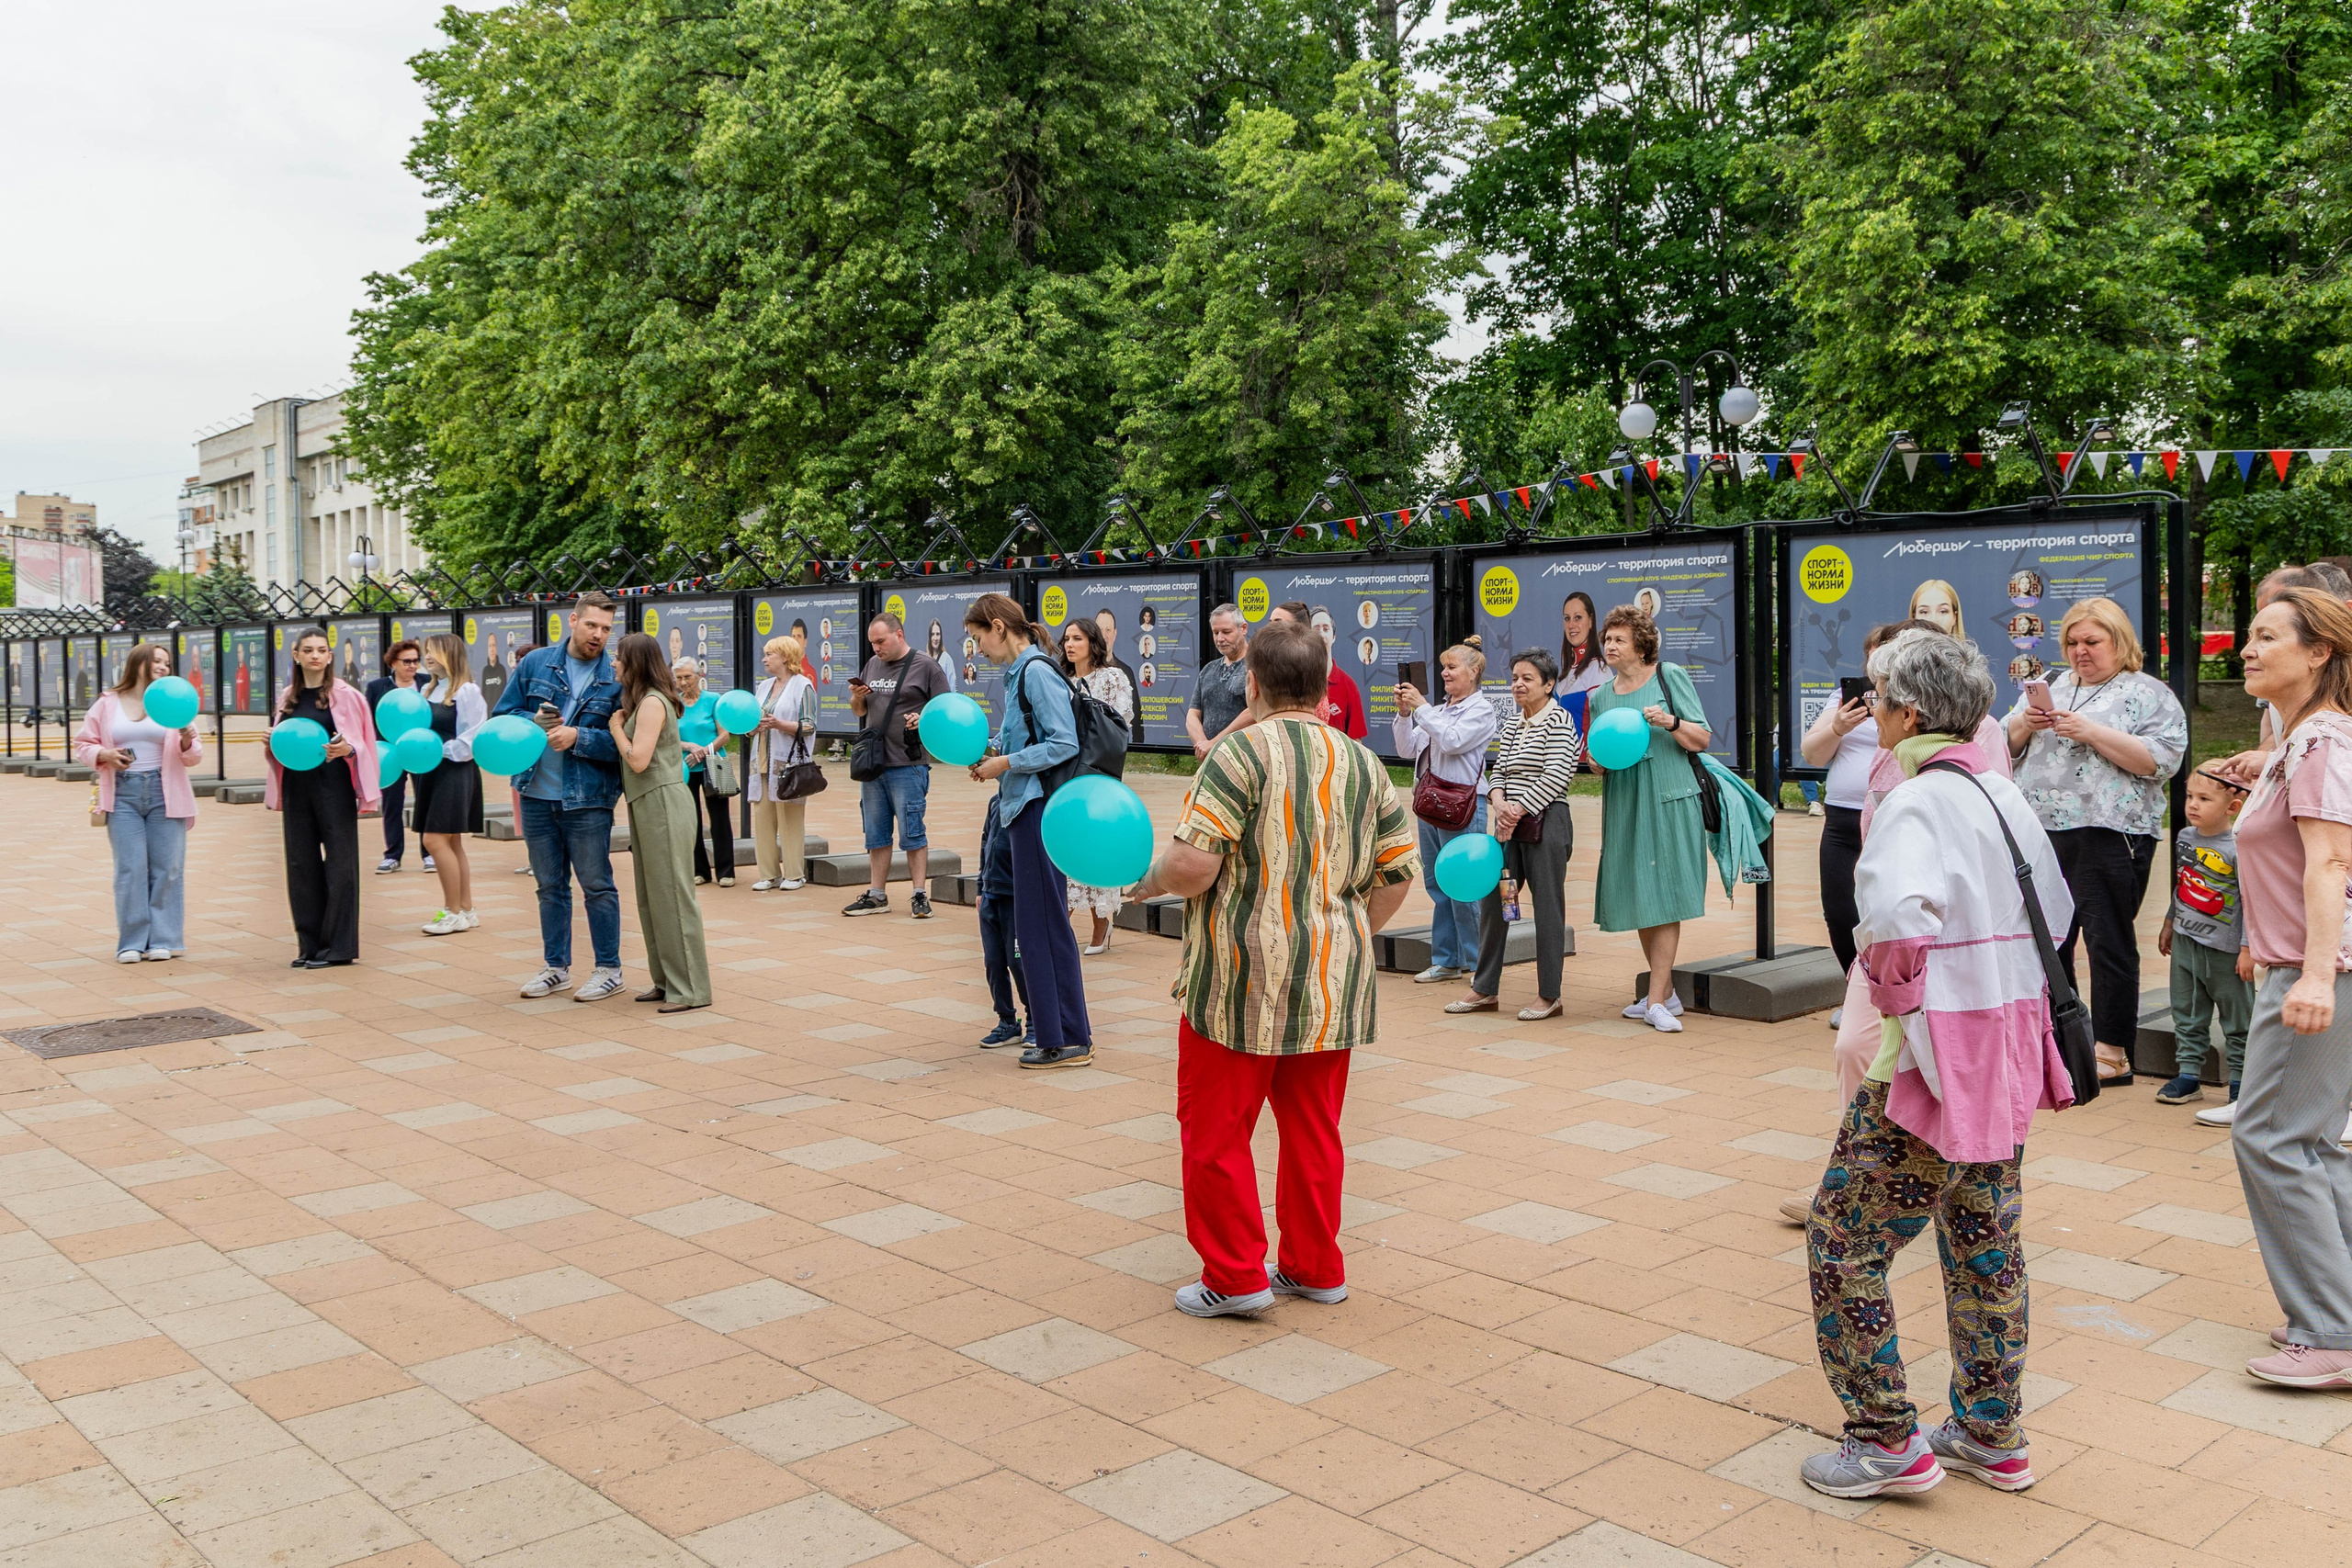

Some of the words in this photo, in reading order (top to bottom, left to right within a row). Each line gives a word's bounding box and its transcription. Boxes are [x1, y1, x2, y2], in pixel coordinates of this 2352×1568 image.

[1883, 539, 1972, 558] Люберцы
[1985, 536, 2075, 553] территория
[2079, 532, 2135, 547] спорта
[2039, 554, 2086, 563] ФЕДЕРАЦИЯ
[2103, 552, 2135, 560] СПОРТА
[1542, 560, 1607, 577] Люберцы
[1618, 558, 1684, 571] территория
[1686, 555, 1727, 567] спорта
[1807, 558, 1837, 569] СПОРТ
[1807, 569, 1844, 580] НОРМА
[1286, 575, 1338, 589] Люберцы
[1345, 574, 1396, 586] территория
[1397, 573, 1430, 585] спорта
[1485, 578, 1508, 587] СПОРТ
[1807, 580, 1844, 590] ЖИЗНИ
[1081, 583, 1123, 596] Люберцы
[1129, 583, 1170, 593] территория
[1171, 582, 1197, 592] спорта
[1485, 587, 1513, 596] НОРМА
[1485, 596, 1513, 605] ЖИЗНИ
[869, 678, 898, 688] adida
[1140, 704, 1167, 712] АЛЕКСЕЙ
[1140, 713, 1168, 721] ЛЬВОВИЧ
